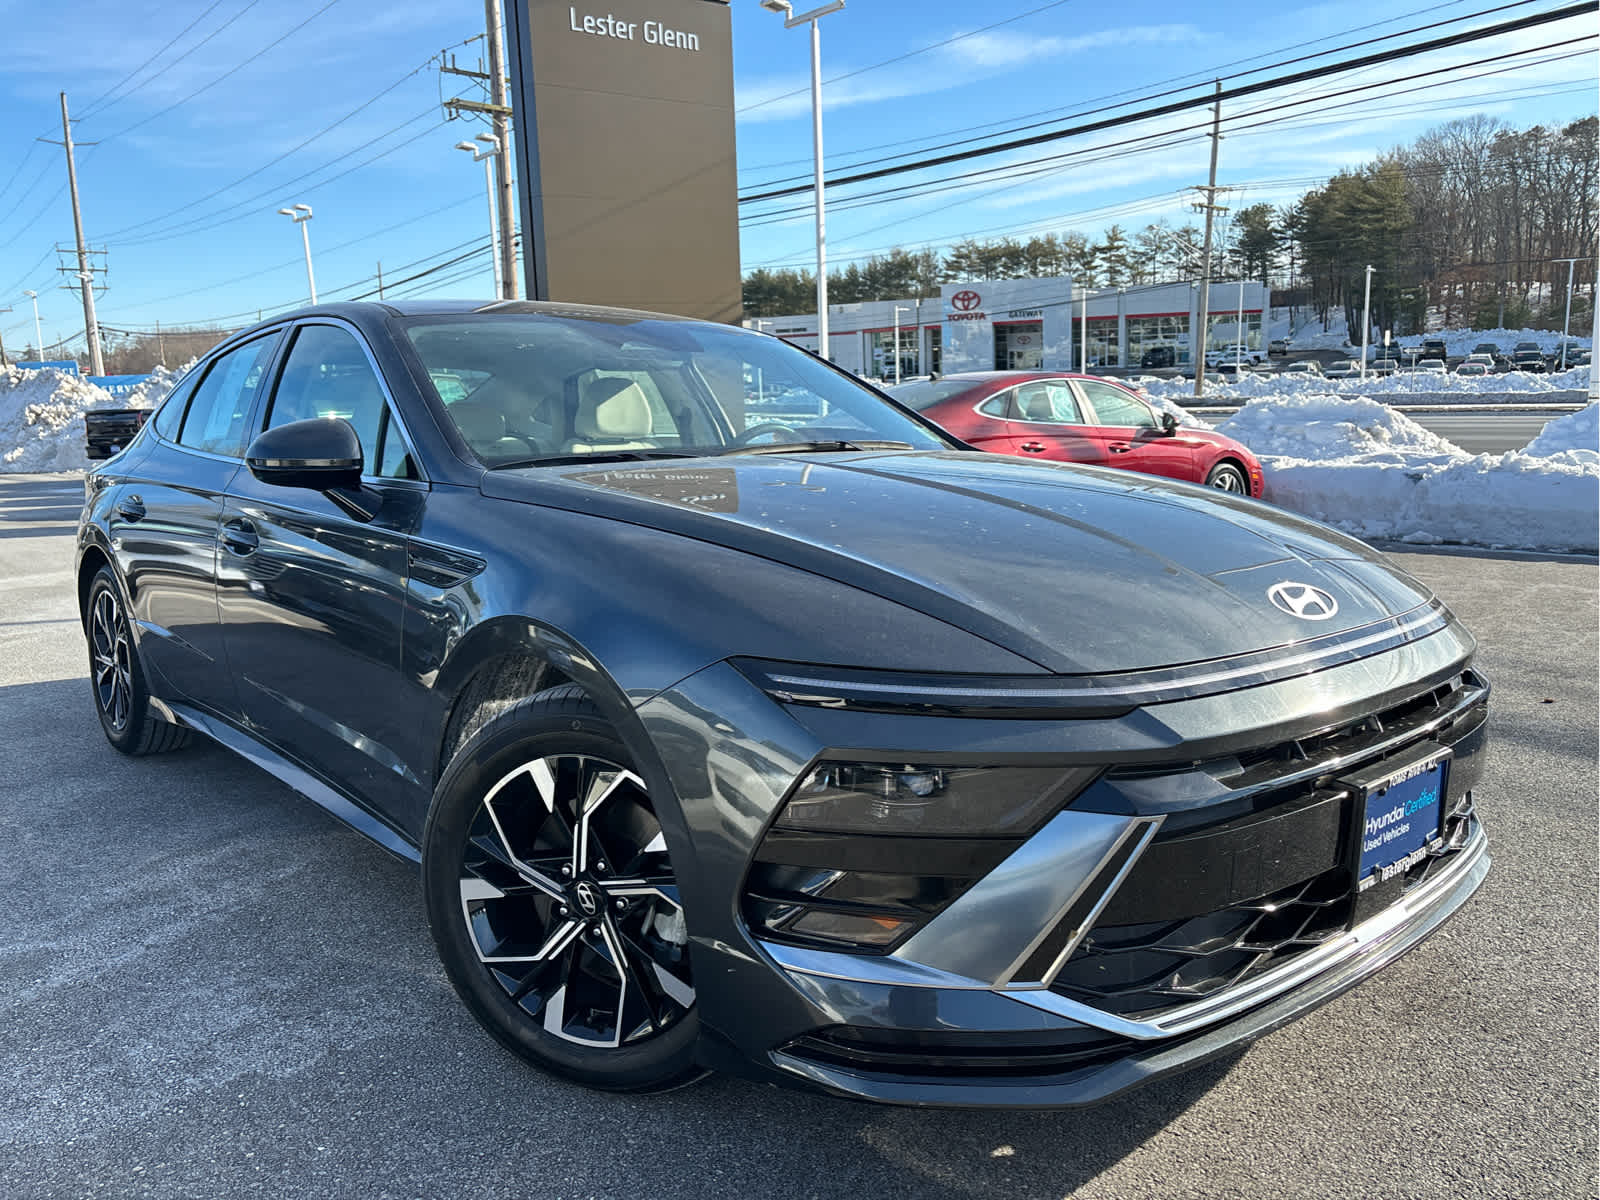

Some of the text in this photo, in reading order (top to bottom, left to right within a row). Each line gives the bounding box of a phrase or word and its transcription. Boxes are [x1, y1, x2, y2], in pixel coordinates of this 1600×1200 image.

[569, 7, 700, 51] Lester Glenn
[947, 312, 986, 322] TOYOTA
[1365, 785, 1437, 835] Hyundai Certified
[1364, 822, 1410, 852] Used Vehicles
